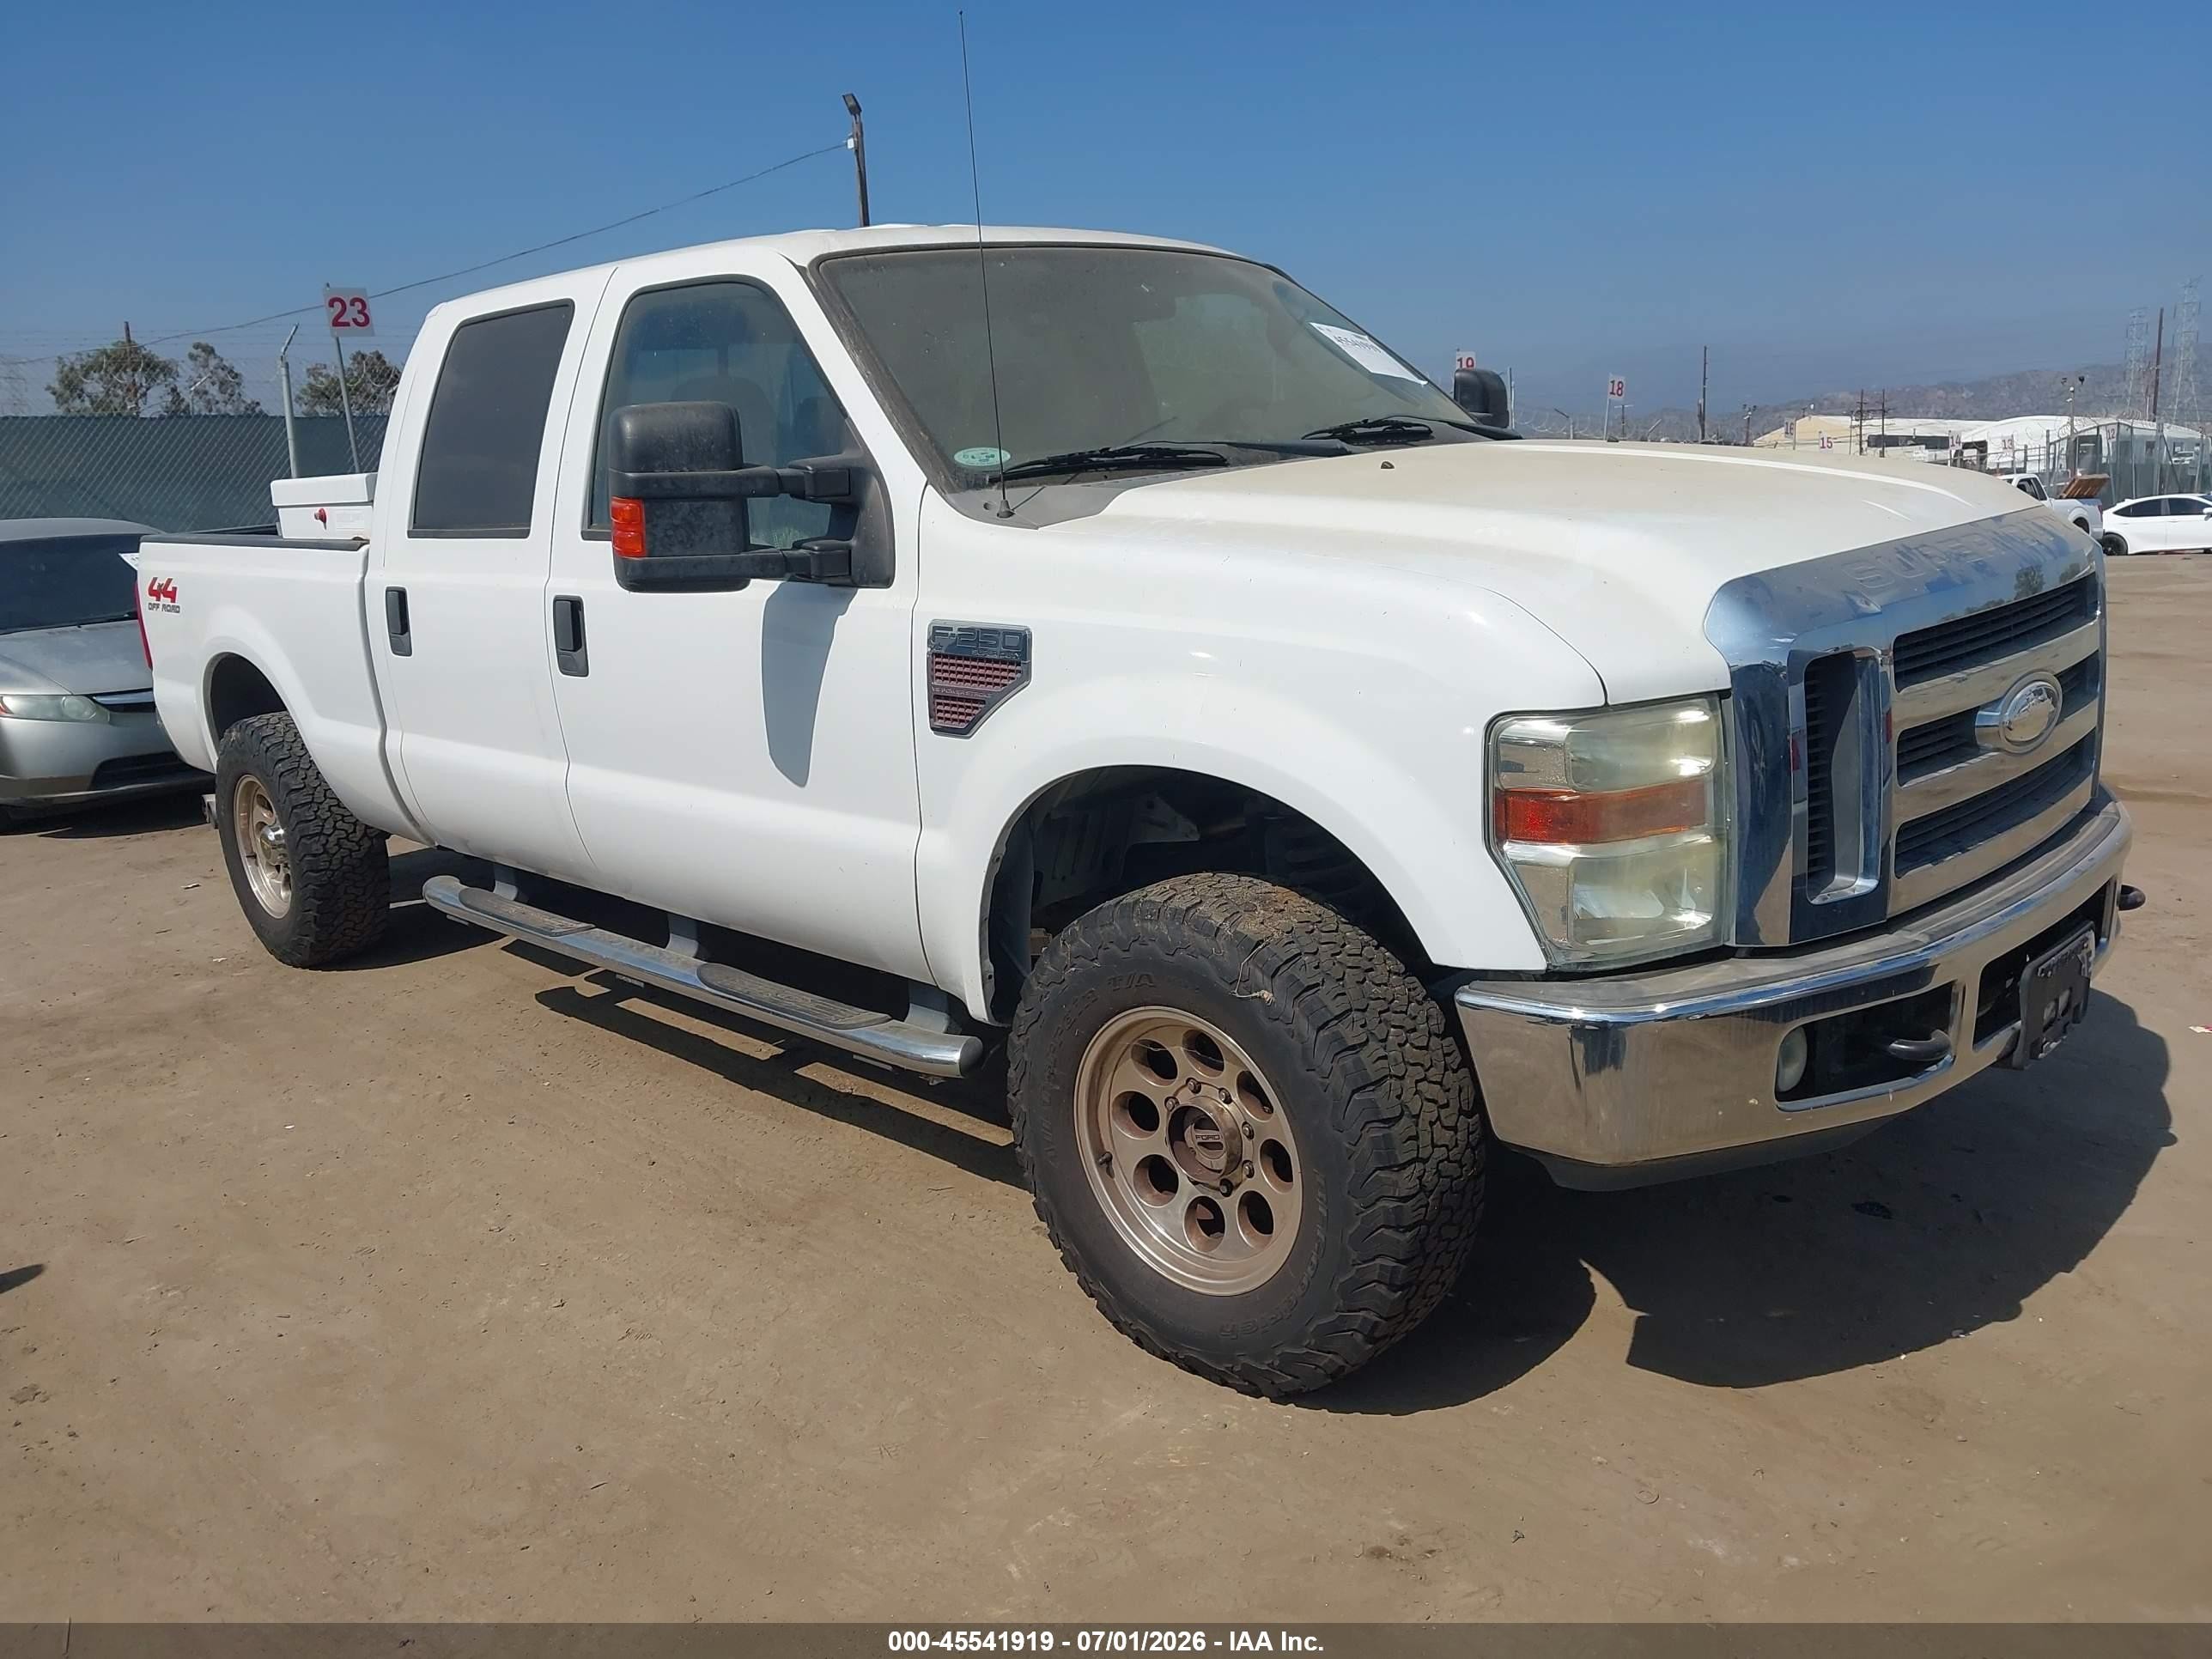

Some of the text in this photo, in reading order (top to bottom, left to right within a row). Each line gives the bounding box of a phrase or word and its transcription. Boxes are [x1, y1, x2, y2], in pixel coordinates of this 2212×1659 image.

[328, 297, 370, 327] 23
[1609, 380, 1624, 397] 18
[1950, 434, 1961, 447] 14
[2107, 428, 2116, 440] 12
[1820, 436, 1833, 449] 15
[2002, 439, 2013, 449] 13
[148, 602, 180, 614] OFF ROAD
[933, 625, 1023, 652] F-250
[1107, 971, 1157, 992] T/A
